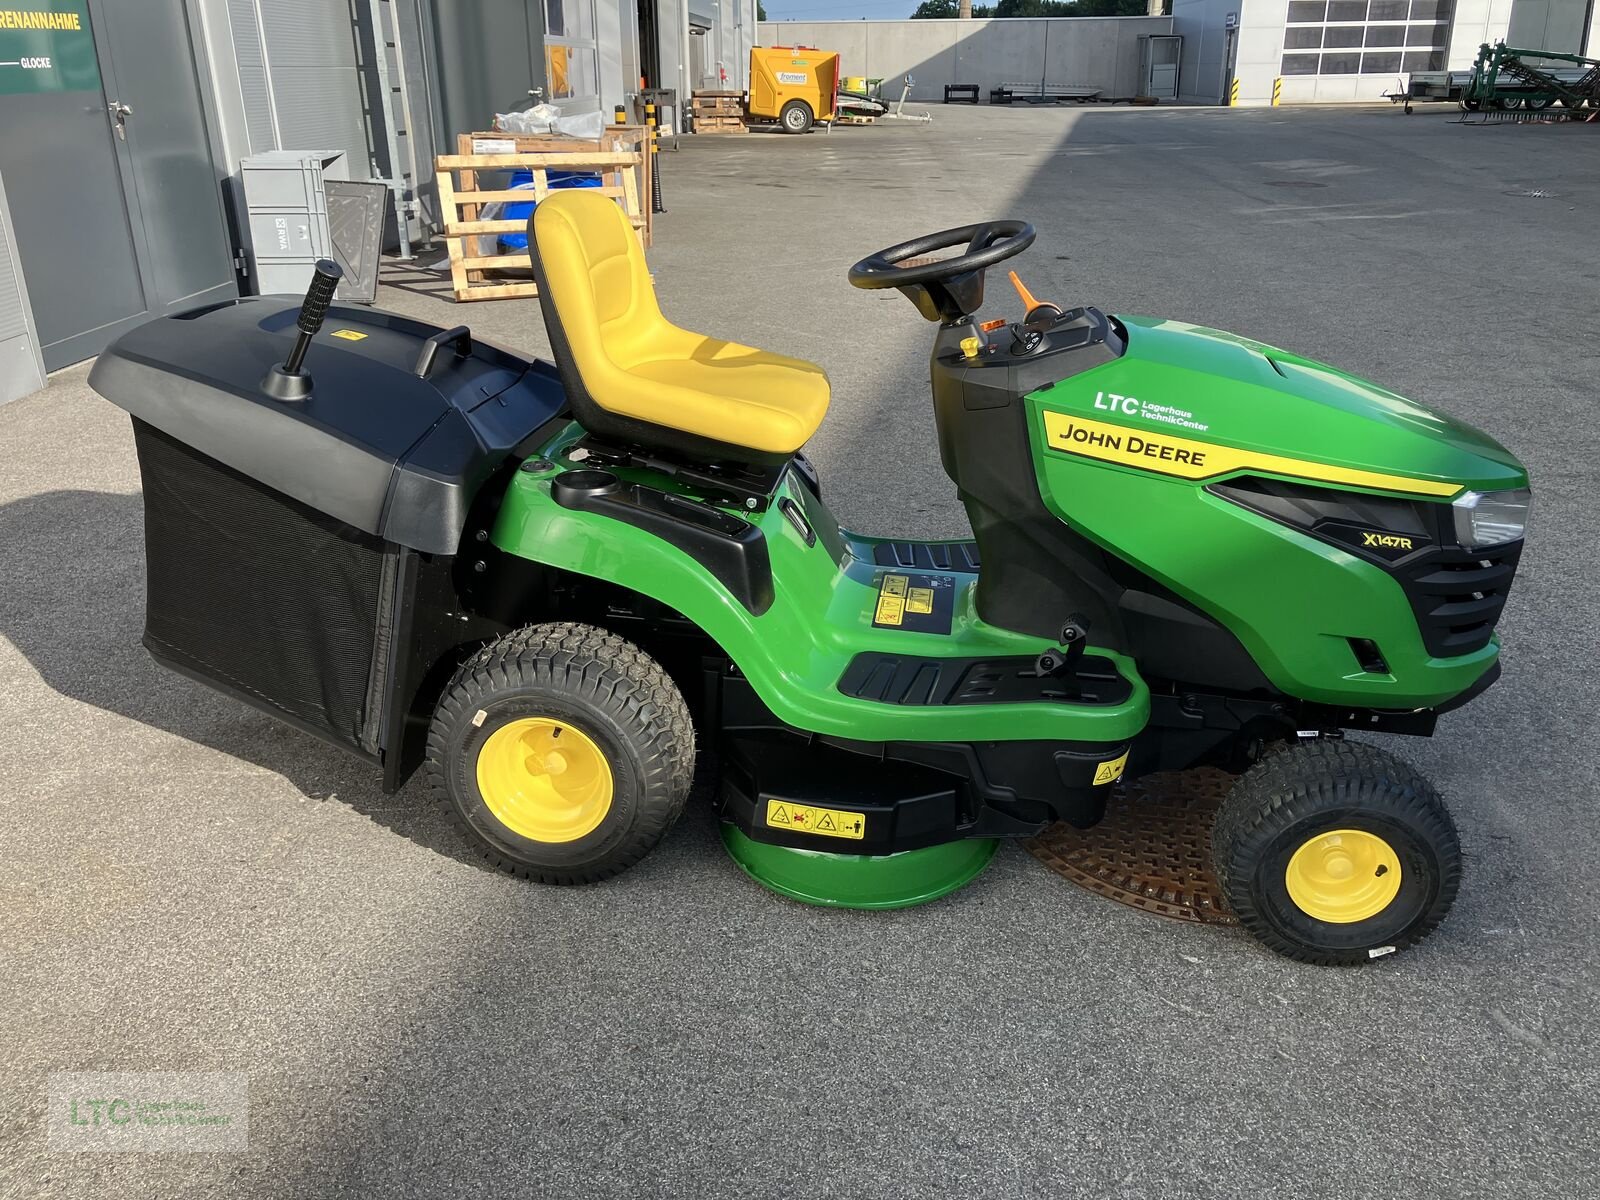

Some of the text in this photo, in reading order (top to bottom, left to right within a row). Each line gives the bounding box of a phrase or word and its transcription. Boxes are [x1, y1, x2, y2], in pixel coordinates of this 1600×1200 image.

[21, 57, 52, 69] GLOCKE
[277, 229, 288, 250] RWA
[1094, 391, 1139, 415] LTC
[1142, 400, 1192, 419] Lagerhaus
[1140, 410, 1208, 431] TechnikCenter
[1059, 423, 1206, 467] JOHN DEERE
[1362, 532, 1412, 550] X147R
